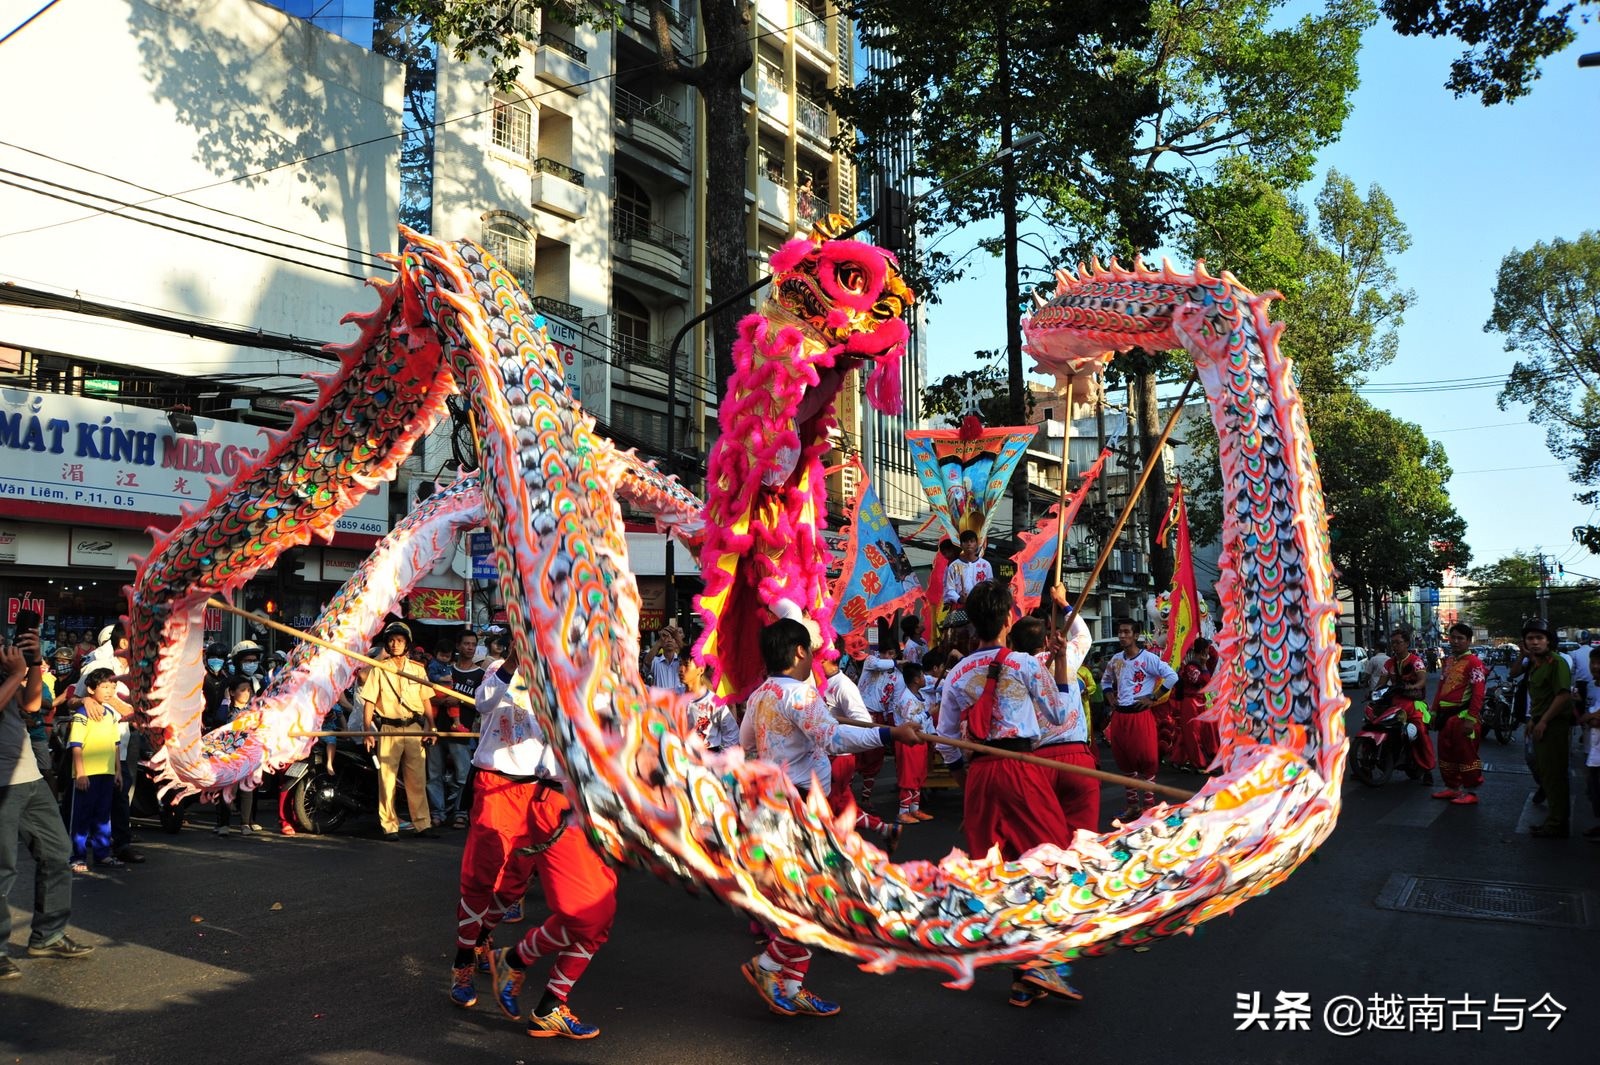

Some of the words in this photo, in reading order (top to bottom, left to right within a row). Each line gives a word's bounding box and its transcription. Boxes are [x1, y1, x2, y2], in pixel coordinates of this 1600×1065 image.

[0, 396, 70, 455] MẮT
[76, 416, 157, 466] KÍNH
[75, 491, 107, 505] P.11,
[114, 495, 135, 507] Q.5
[336, 520, 358, 530] 3859
[360, 523, 382, 533] 4680
